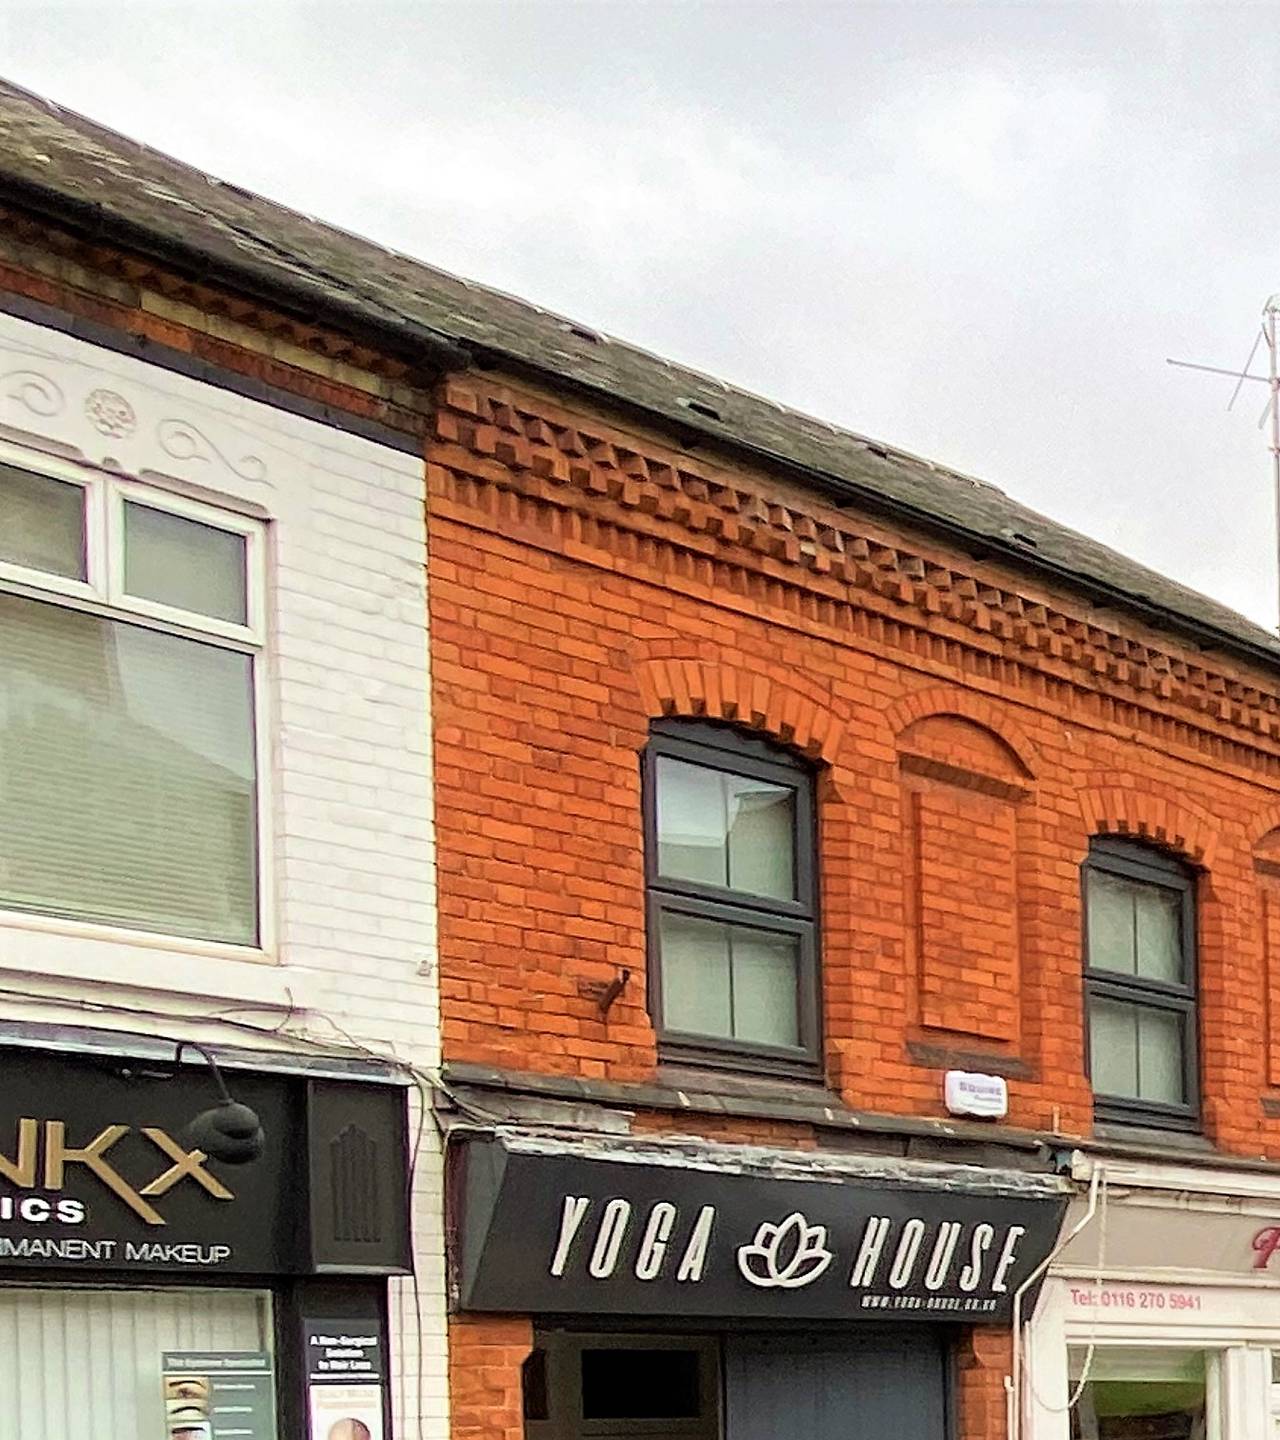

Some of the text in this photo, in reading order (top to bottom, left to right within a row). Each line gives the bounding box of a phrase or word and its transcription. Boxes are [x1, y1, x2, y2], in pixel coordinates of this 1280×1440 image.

[125, 1242, 231, 1263] MAKEUP
[551, 1196, 1026, 1293] YOGA HOUSE
[1101, 1291, 1135, 1308] 0116
[1139, 1292, 1165, 1309] 270
[1169, 1294, 1201, 1310] 5941
